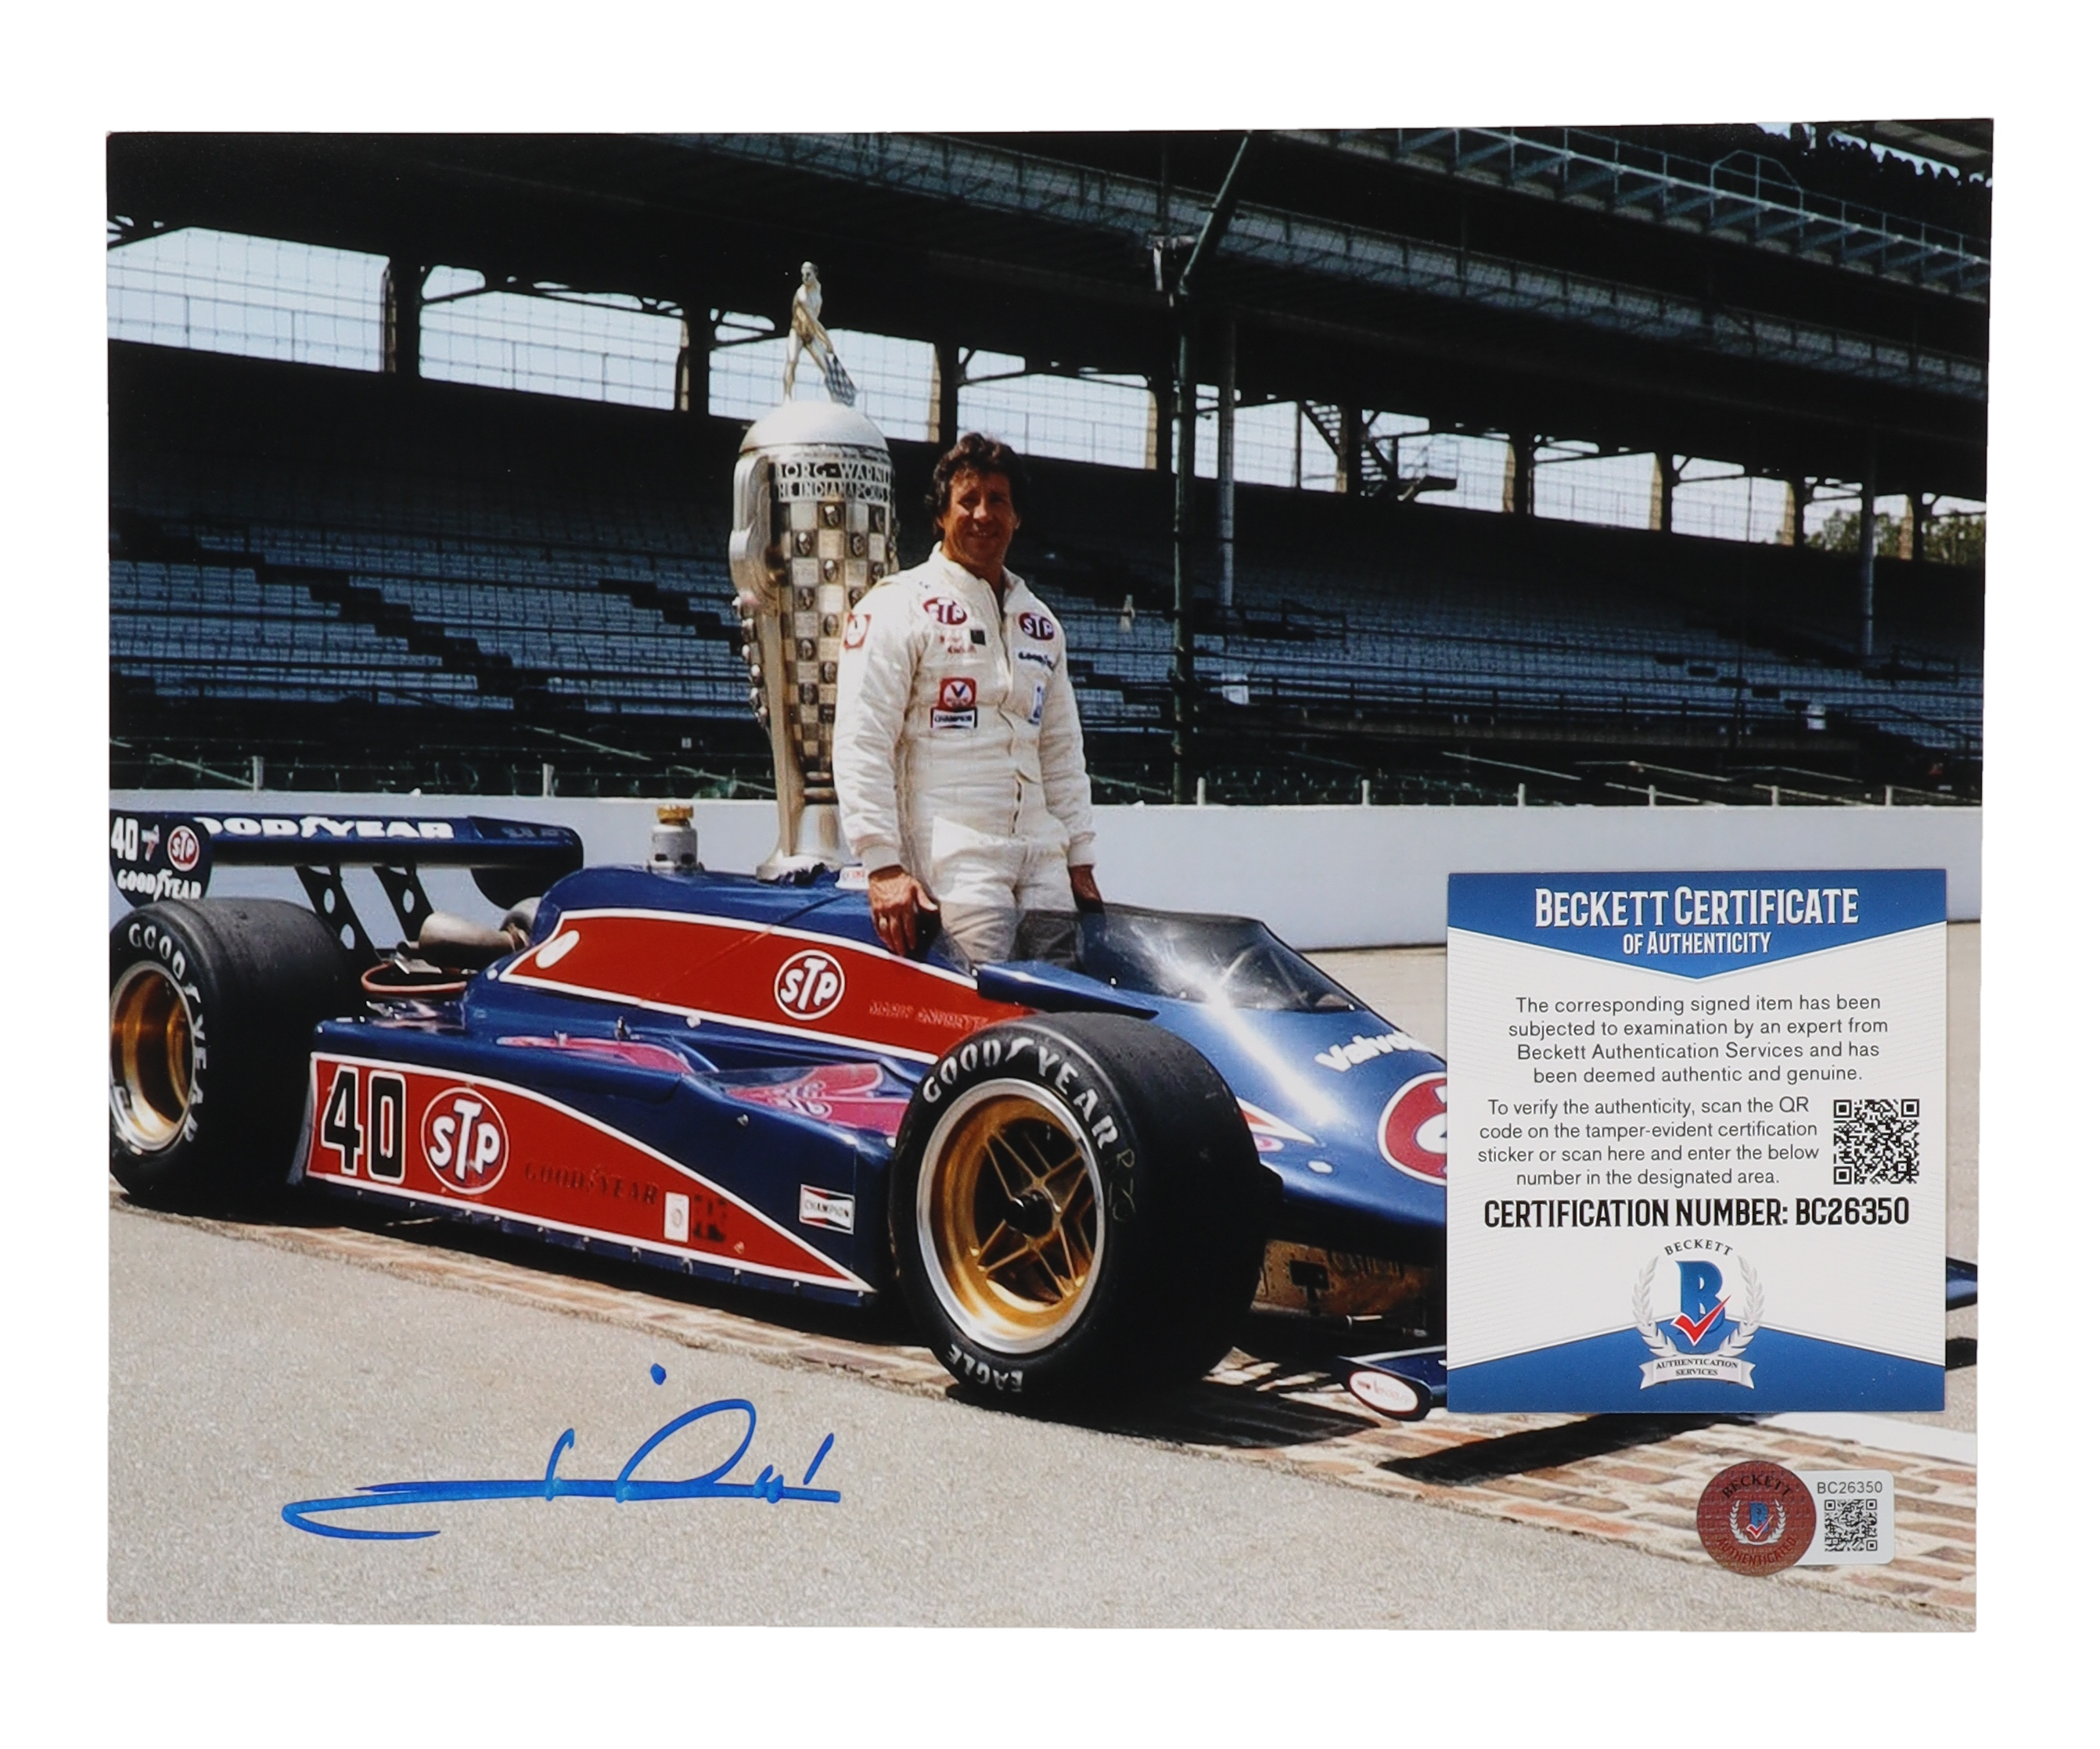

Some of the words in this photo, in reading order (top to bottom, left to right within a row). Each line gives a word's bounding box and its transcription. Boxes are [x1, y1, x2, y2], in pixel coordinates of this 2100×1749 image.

[1023, 612, 1055, 639] STP
[110, 817, 139, 861] 40
[1534, 887, 1670, 928] BECKETT
[1673, 885, 1860, 926] CERTIFICATE
[1623, 933, 1645, 955] OF
[1647, 930, 1771, 955] AUTHENTICITY
[779, 956, 840, 1012] STP
[1516, 997, 1548, 1013] The
[1555, 996, 1684, 1017] corresponding
[1691, 994, 1749, 1015] signed
[1757, 994, 1793, 1011] item
[1800, 994, 1830, 1010] has
[1836, 993, 1880, 1010] been
[1508, 1020, 1595, 1041] subjected
[1601, 1022, 1618, 1036] to
[1624, 1018, 1728, 1036] examination
[1734, 1018, 1754, 1039] by
[1760, 1022, 1781, 1034] an
[1787, 1019, 1842, 1038] expert
[1848, 1017, 1888, 1033] from
[1518, 1043, 1586, 1060] Beckett
[1591, 1043, 1719, 1059] Authentication
[1725, 1041, 1803, 1058] Services
[1810, 1041, 1842, 1058] and
[1849, 1041, 1879, 1057] has
[1534, 1068, 1577, 1083] been
[1584, 1066, 1655, 1083] deemed
[1661, 1065, 1742, 1082] authentic
[1748, 1065, 1781, 1081] and
[1787, 1065, 1862, 1086] genuine.
[1487, 1099, 1508, 1115] To
[1513, 1098, 1559, 1119] verify
[1563, 1098, 1589, 1115] the
[1595, 1097, 1695, 1119] authenticity,
[1701, 1101, 1742, 1113] scan
[1747, 1097, 1774, 1113] the
[1779, 1096, 1809, 1113] QR
[320, 1064, 407, 1184] 40
[1480, 1122, 1523, 1139] code
[1527, 1127, 1548, 1139] on
[1554, 1122, 1580, 1138] the
[1585, 1121, 1713, 1142] tamper-evident
[1718, 1120, 1818, 1137] certification
[428, 1097, 502, 1180] STP
[1478, 1146, 1534, 1162] sticker
[1539, 1150, 1557, 1162] or
[1562, 1150, 1602, 1162] scan
[1608, 1145, 1645, 1162] here
[1651, 1144, 1682, 1161] and
[1688, 1146, 1731, 1161] enter
[1736, 1144, 1762, 1160] the
[1768, 1144, 1819, 1160] below
[1516, 1169, 1581, 1186] number
[1587, 1169, 1600, 1185] in
[1606, 1169, 1632, 1185] the
[1638, 1168, 1732, 1189] designated
[1737, 1172, 1779, 1183] area.
[1484, 1199, 1669, 1228] CERTIFICATION
[1676, 1198, 1788, 1226] NUMBER:
[1796, 1197, 1909, 1226] BC26350
[1663, 1238, 1734, 1256] BECKETT
[947, 1343, 1023, 1392] EAGLE
[1656, 1358, 1739, 1370] AUTHENTICATION
[1675, 1368, 1718, 1377] SERVICES
[1721, 1474, 1793, 1499] BECKETT
[1816, 1481, 1883, 1494] BC26350
[1716, 1535, 1797, 1565] AUTHENTICATED
